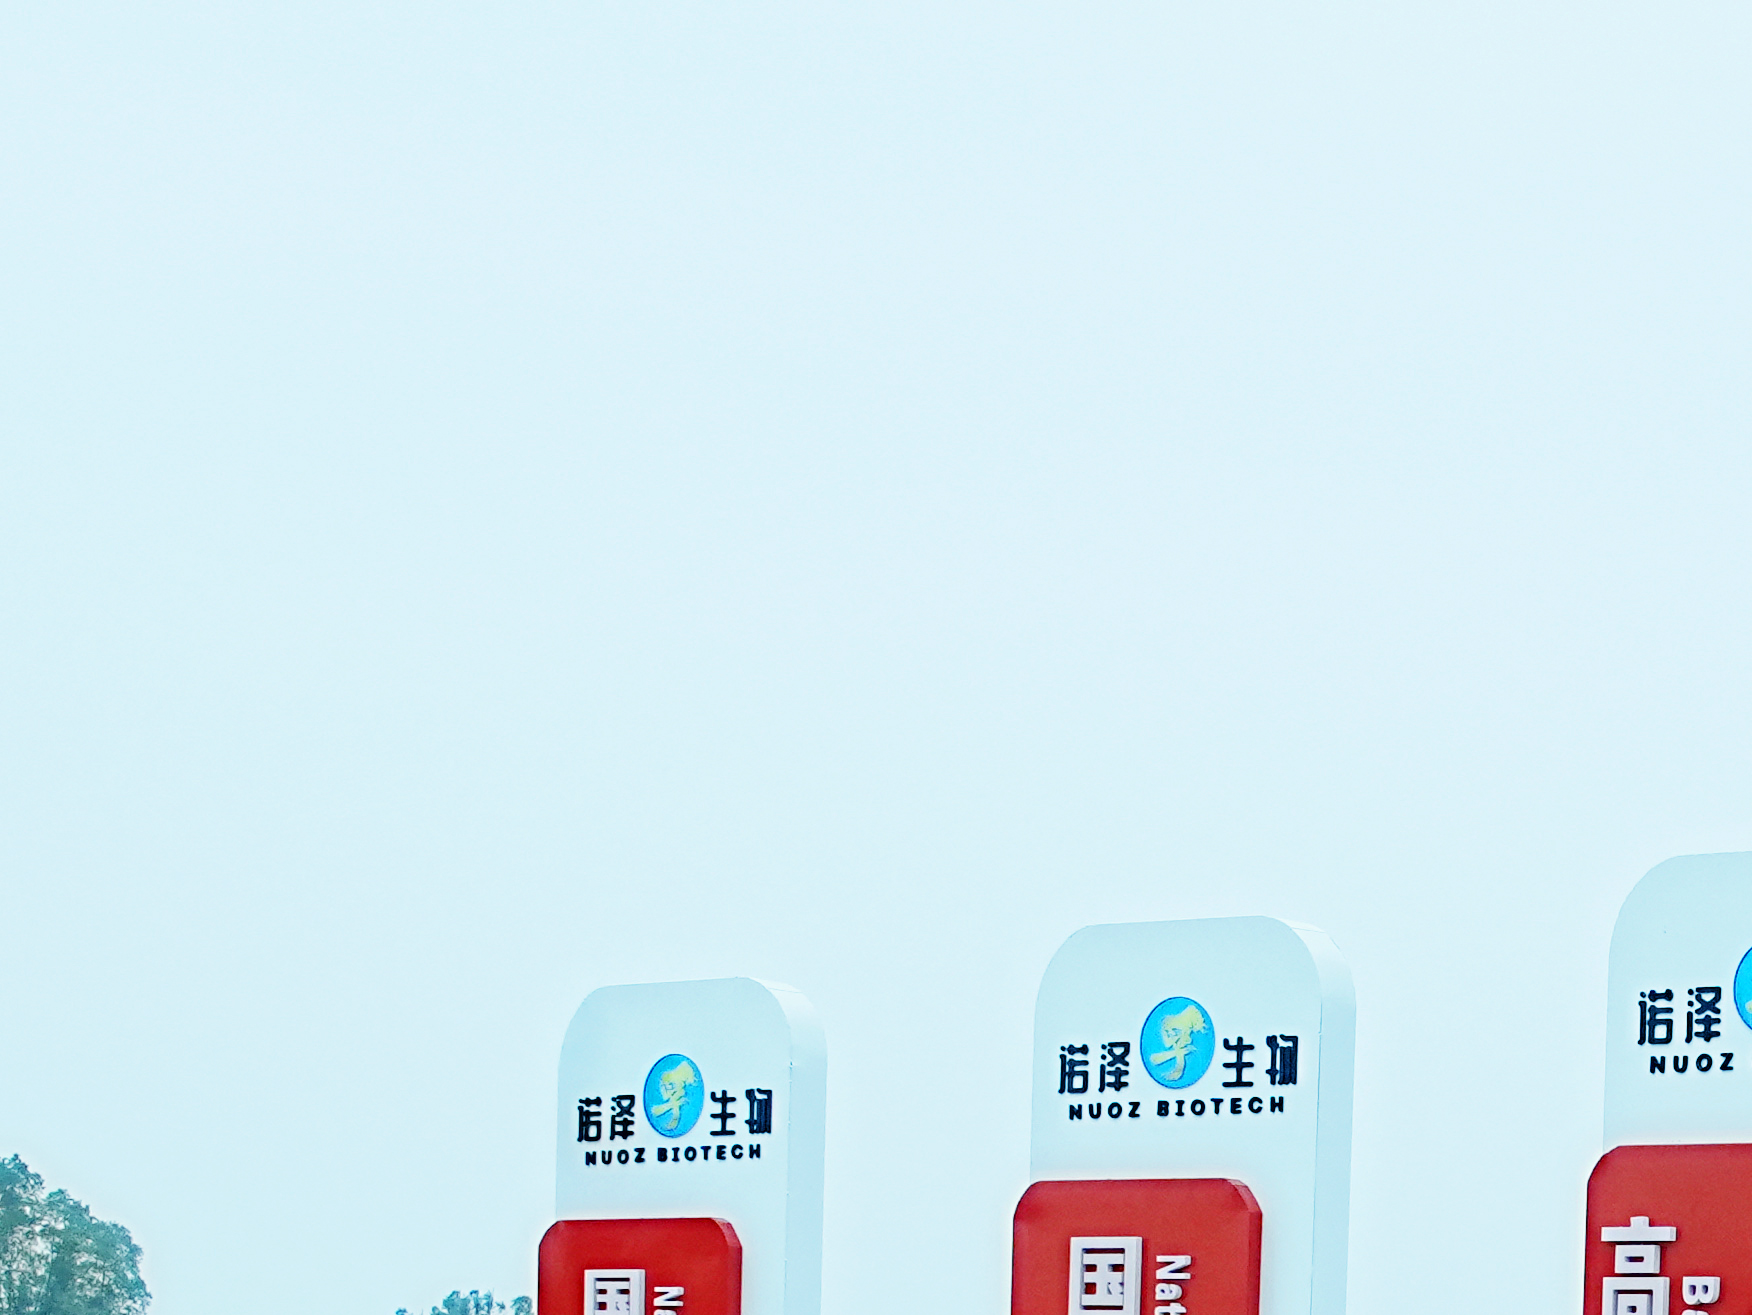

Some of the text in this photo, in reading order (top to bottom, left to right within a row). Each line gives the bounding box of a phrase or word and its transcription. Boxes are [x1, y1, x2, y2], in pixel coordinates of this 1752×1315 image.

[1223, 1035, 1298, 1087] 生物
[1650, 1053, 1733, 1073] NUOZ
[710, 1089, 772, 1135] 生物
[1070, 1097, 1283, 1120] NUOZ BIOTECH
[586, 1144, 760, 1165] NUOZ BIOTECH
